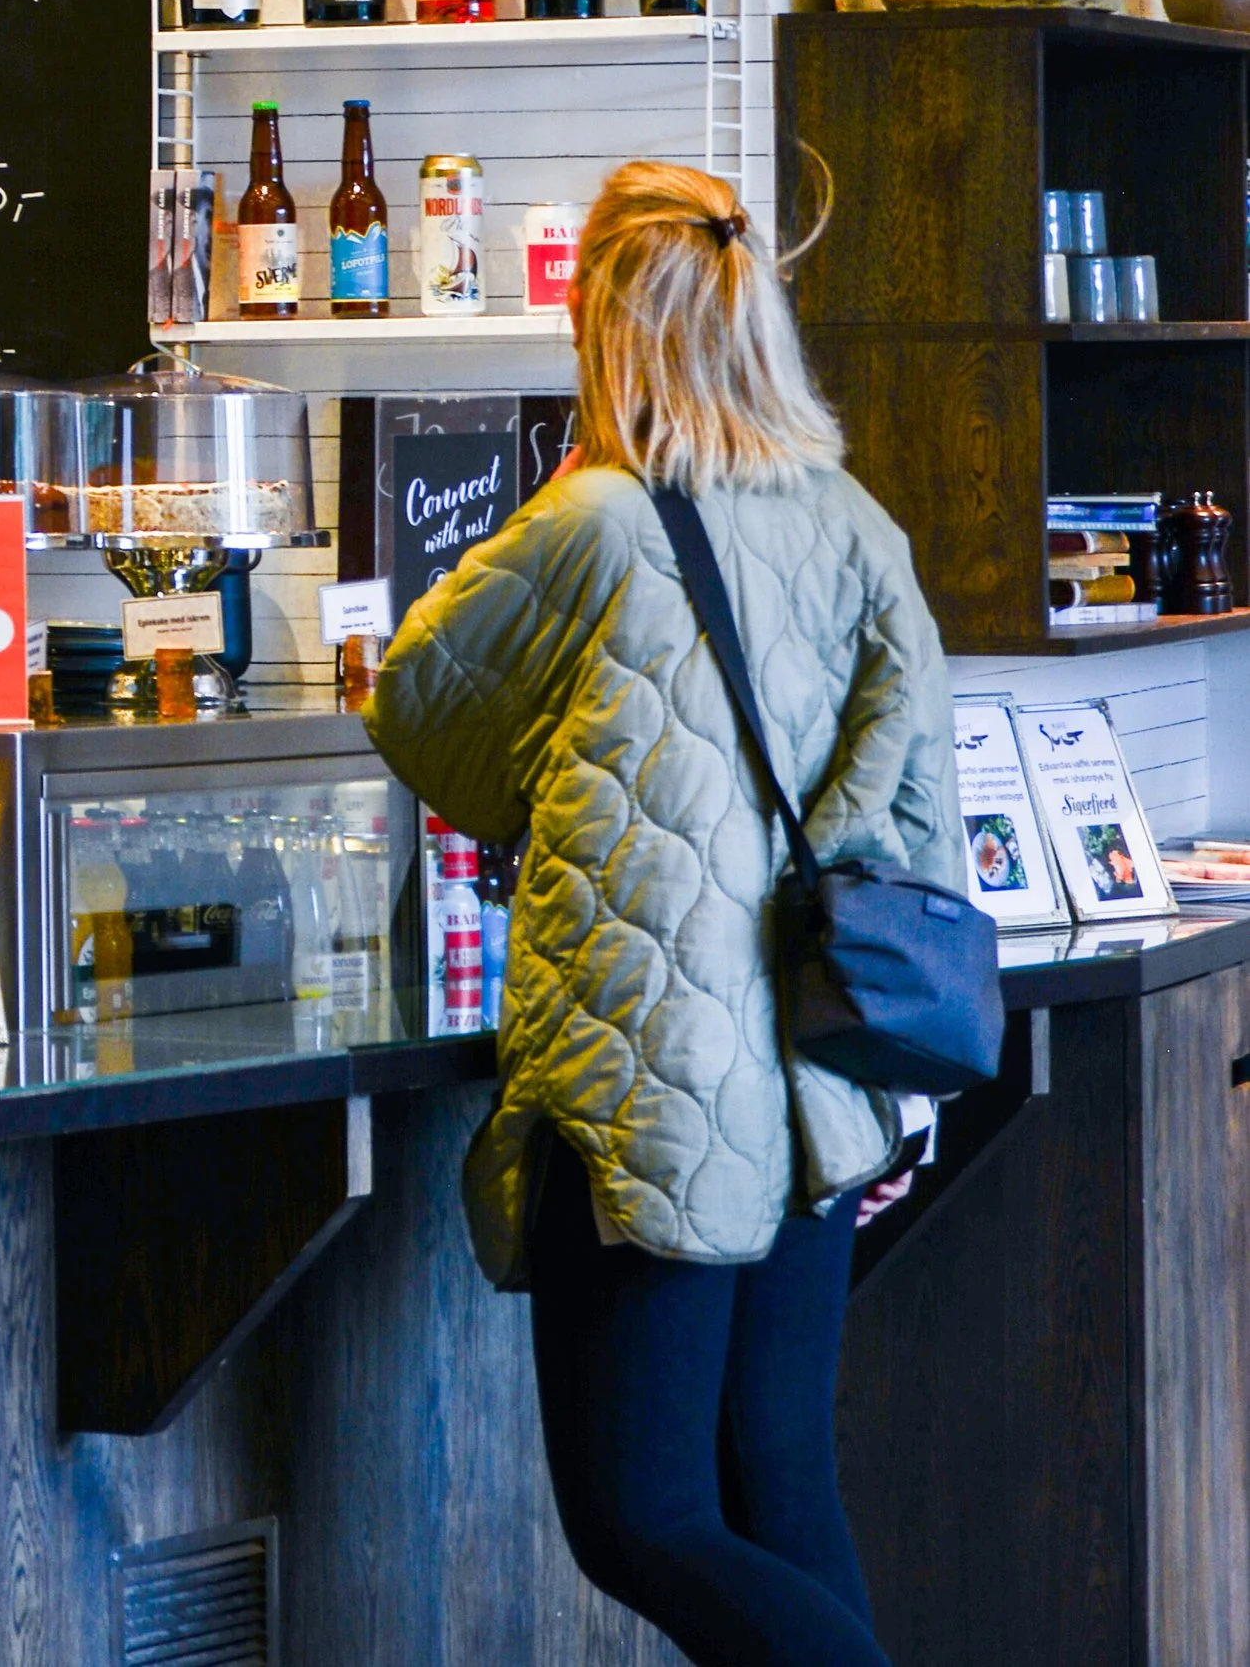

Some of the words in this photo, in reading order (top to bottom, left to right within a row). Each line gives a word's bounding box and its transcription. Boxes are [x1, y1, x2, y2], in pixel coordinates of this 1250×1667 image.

[406, 454, 500, 526] Connect
[425, 509, 461, 553] with
[466, 504, 494, 536] us!
